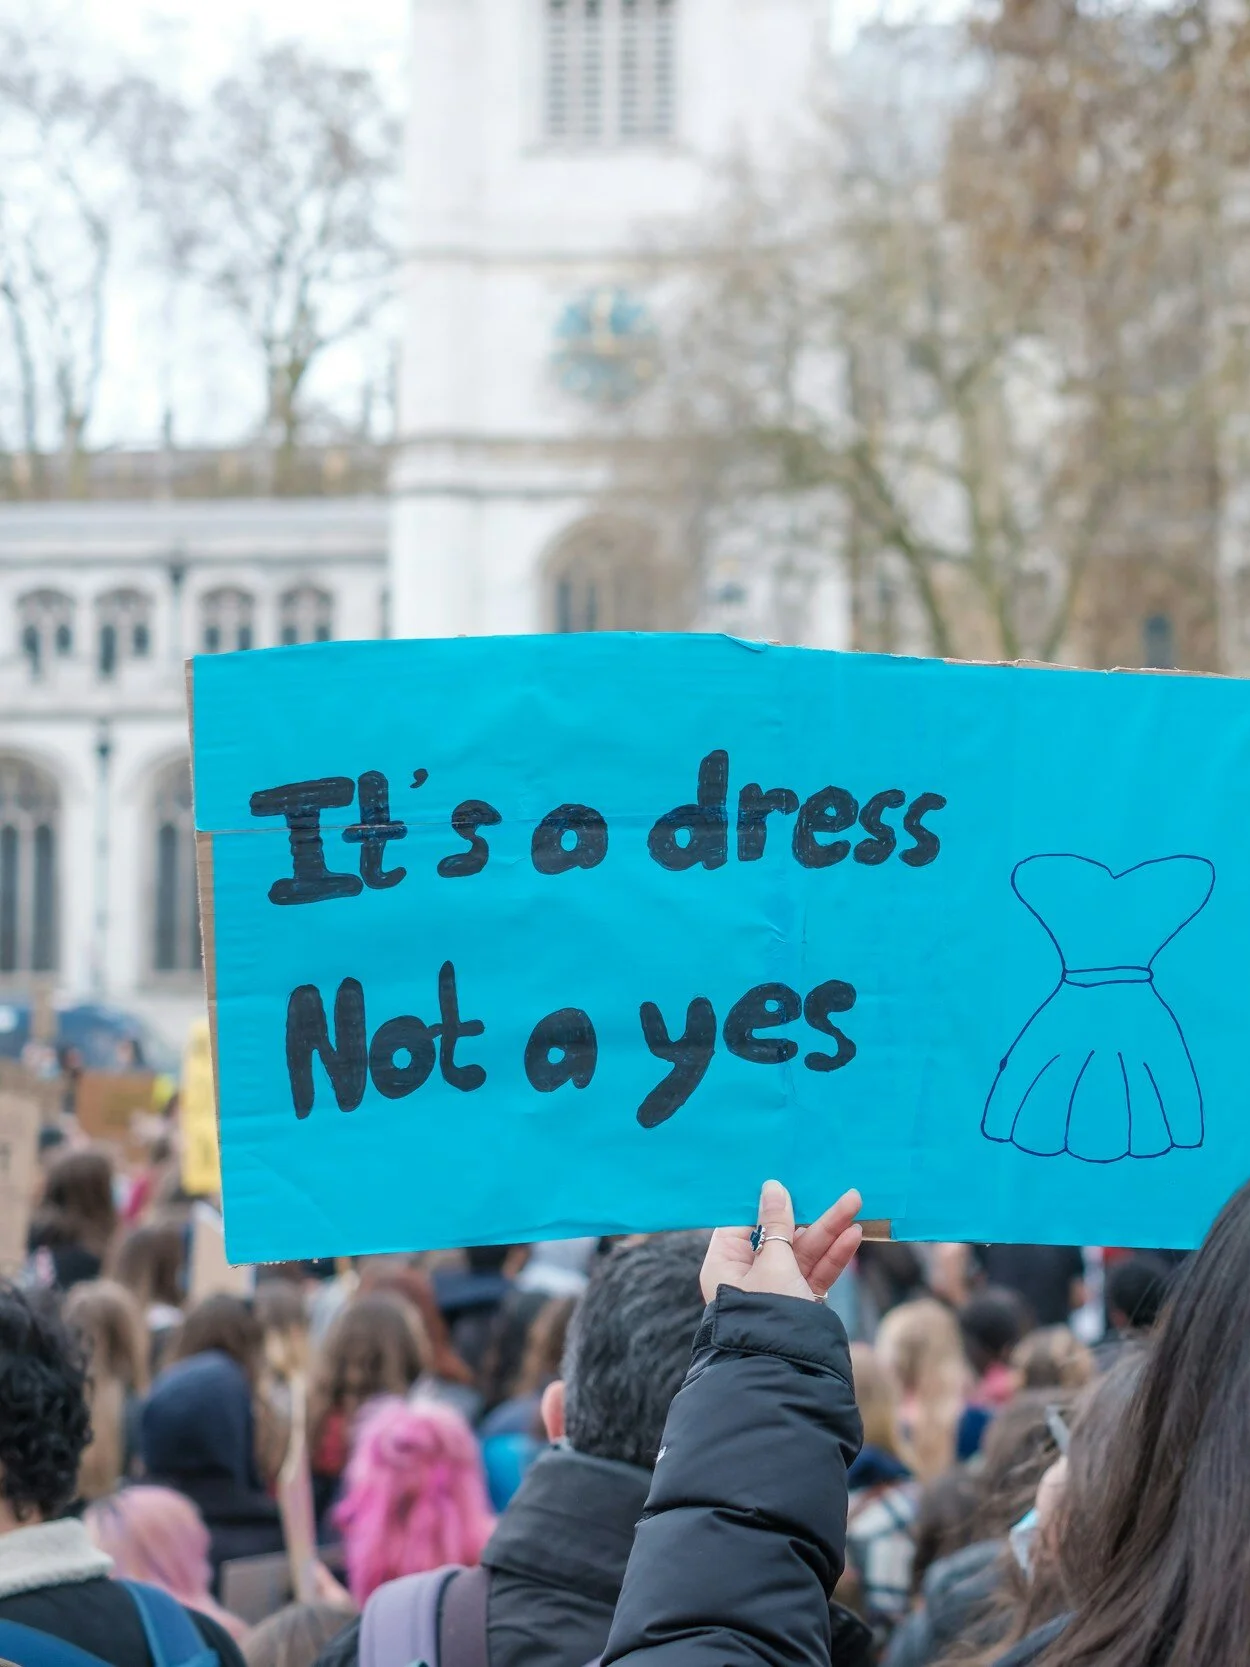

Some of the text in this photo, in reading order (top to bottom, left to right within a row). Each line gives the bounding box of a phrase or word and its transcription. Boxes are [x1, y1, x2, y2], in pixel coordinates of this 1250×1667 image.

[249, 749, 947, 890] It's a dress
[285, 960, 857, 1129] Not a yes
